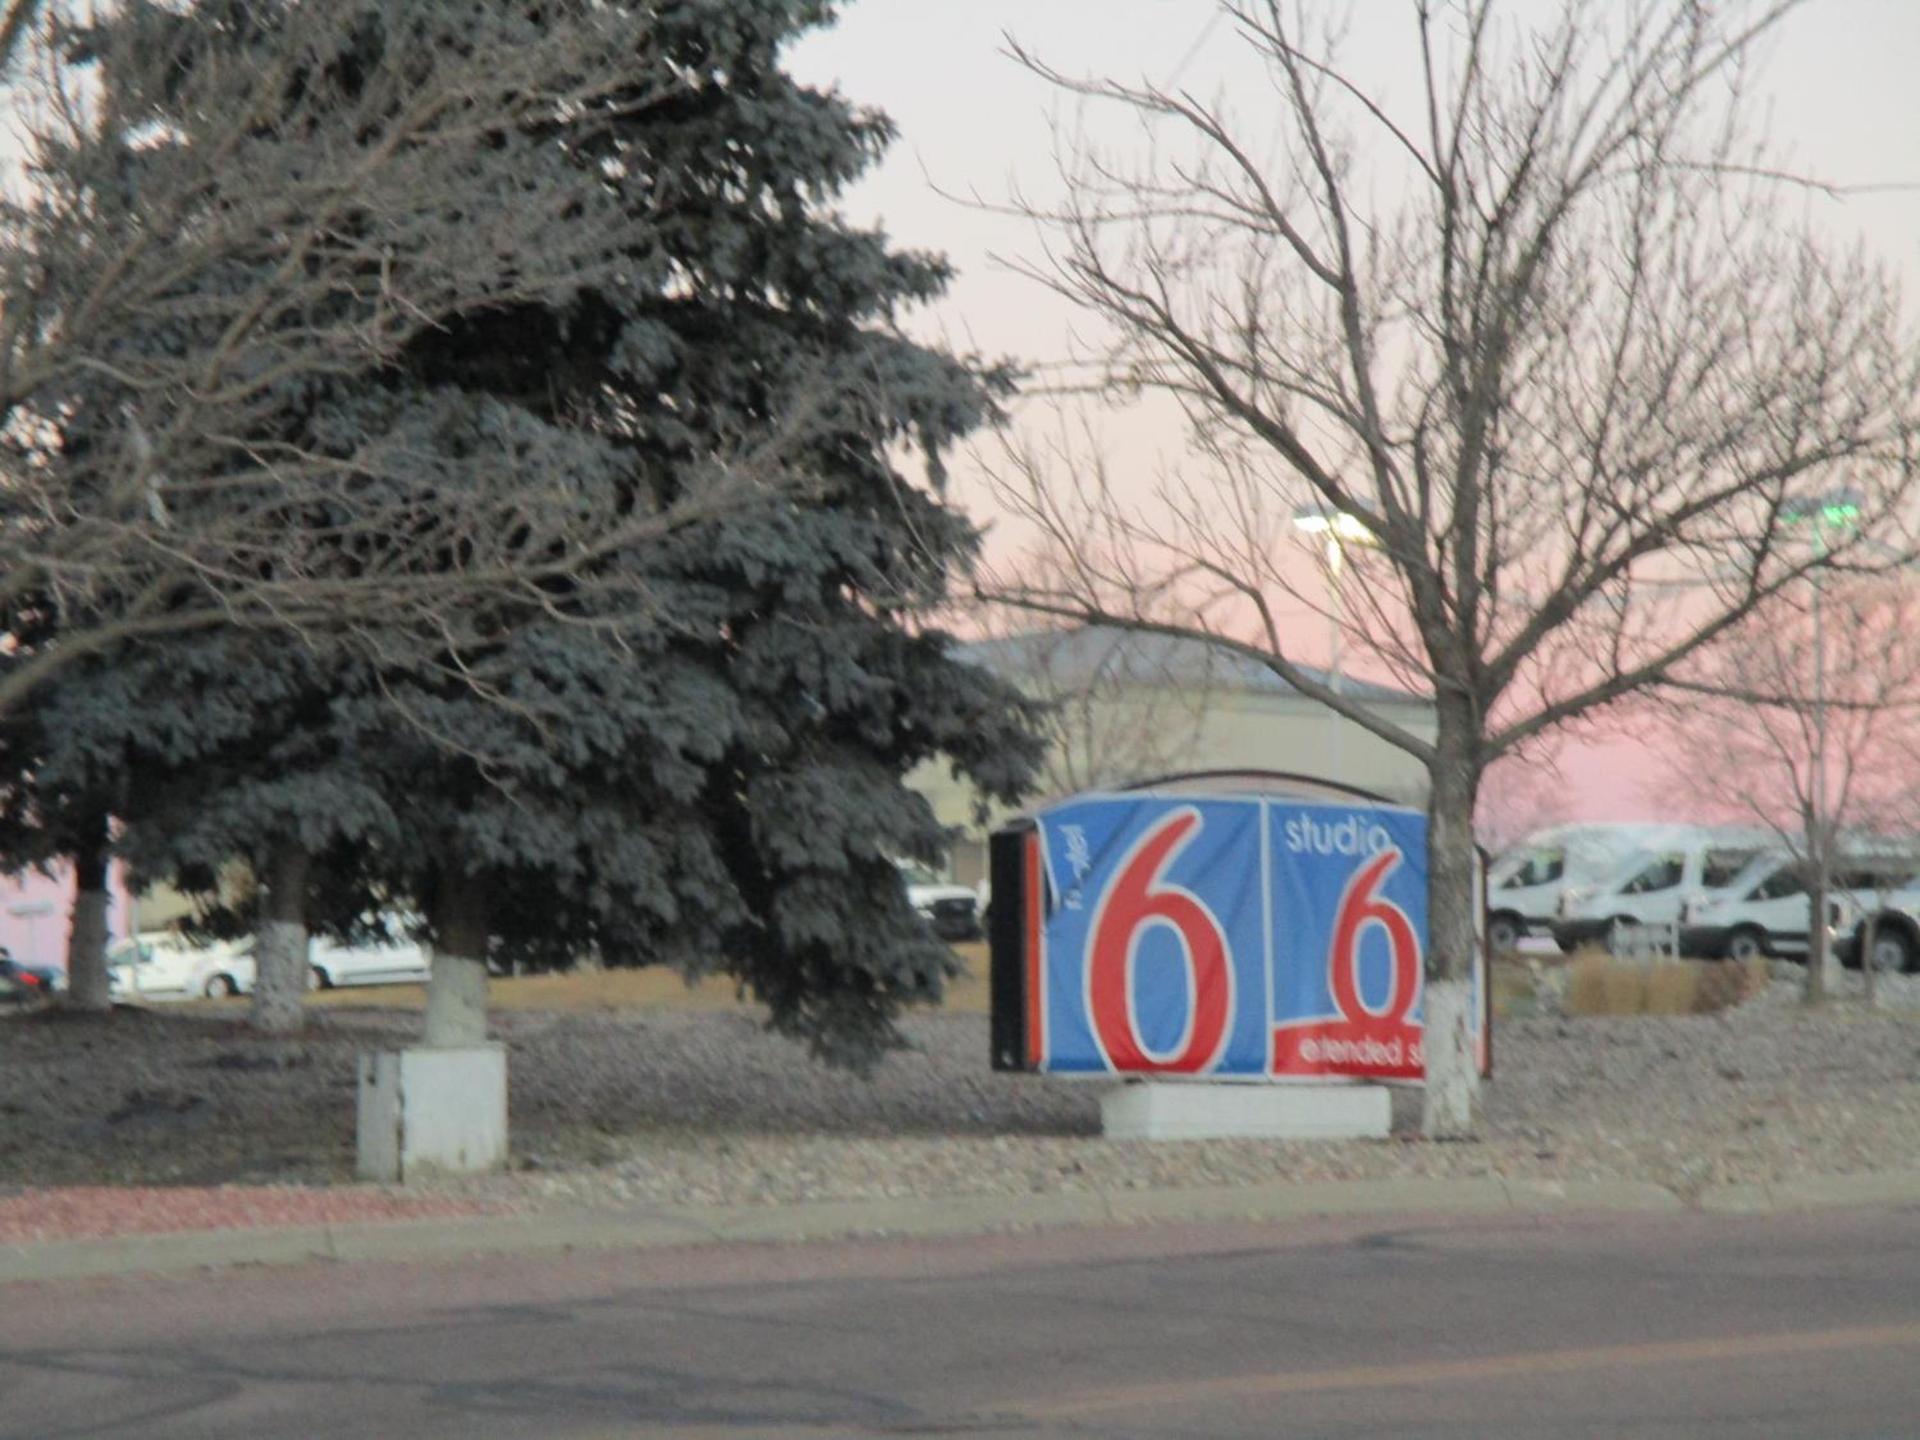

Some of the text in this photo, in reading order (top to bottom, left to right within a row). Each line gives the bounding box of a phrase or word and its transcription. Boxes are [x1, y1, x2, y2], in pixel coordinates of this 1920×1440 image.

[1285, 812, 1391, 857] studio
[1084, 806, 1235, 1074] 6
[1328, 847, 1423, 1026] 6
